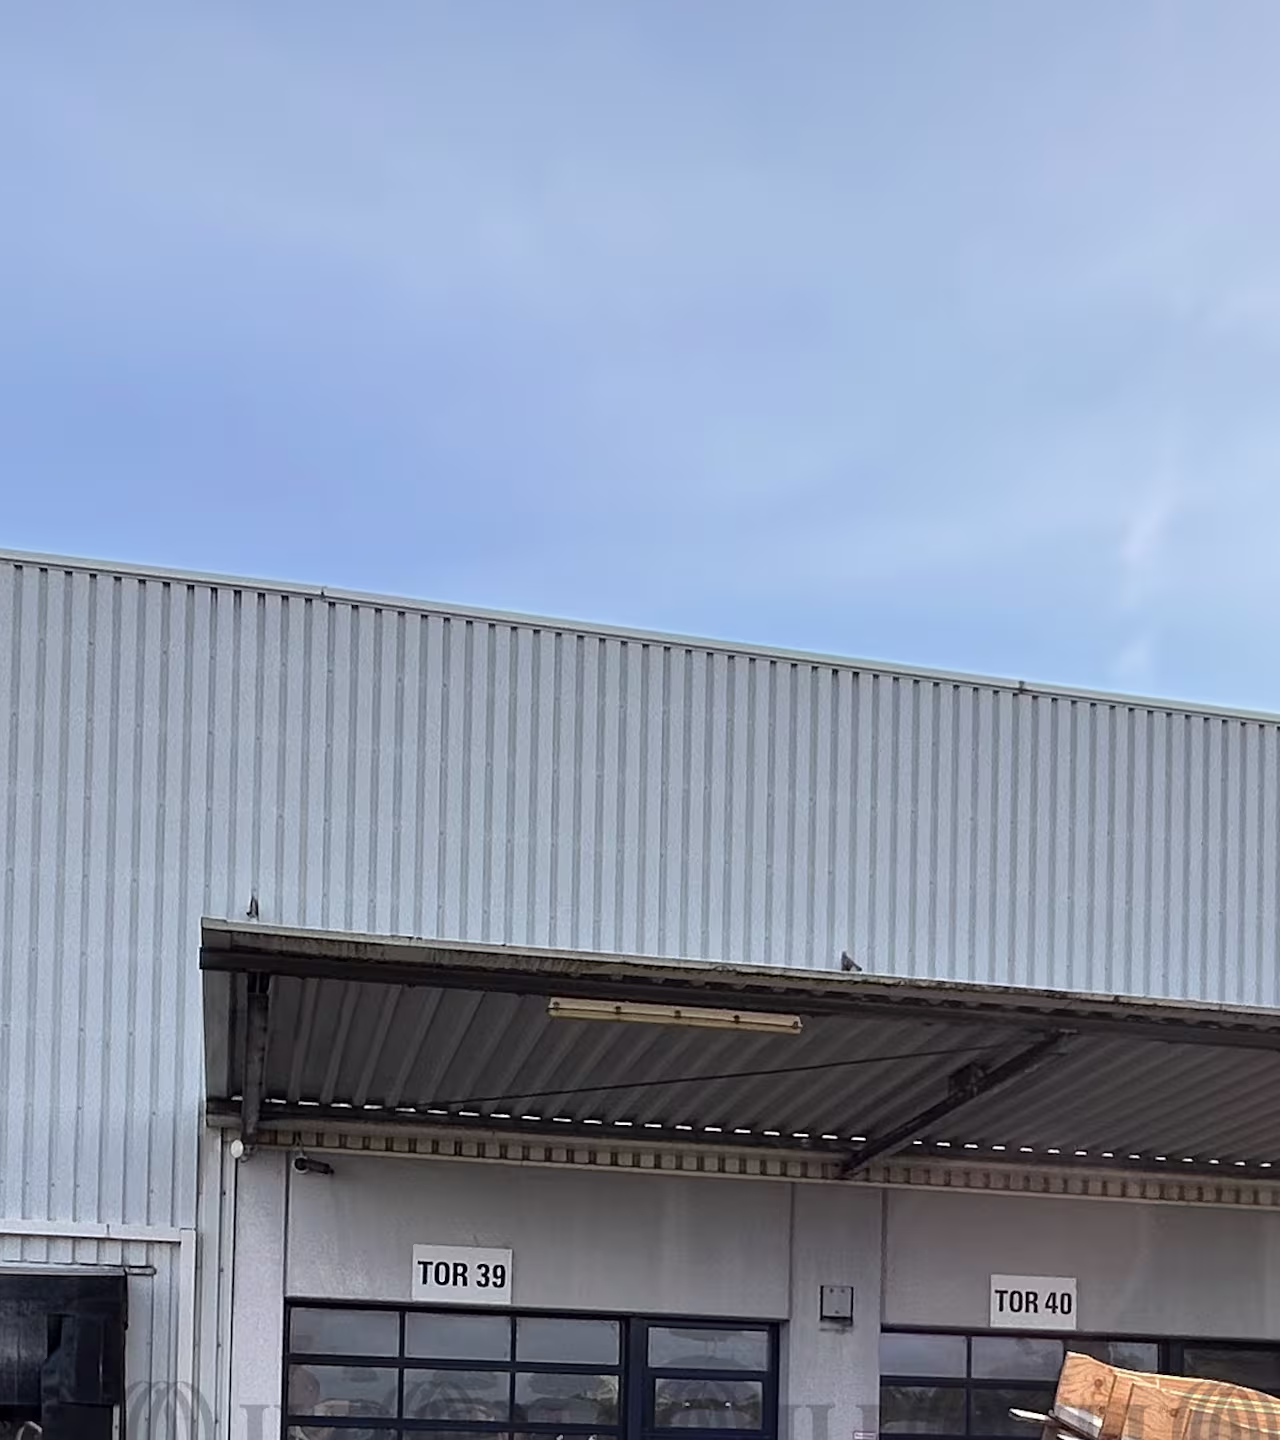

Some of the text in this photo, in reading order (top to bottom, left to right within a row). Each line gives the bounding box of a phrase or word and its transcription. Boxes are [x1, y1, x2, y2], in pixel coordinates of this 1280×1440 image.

[417, 1260, 506, 1288] TOR 39
[994, 1289, 1072, 1315] TOR 40
